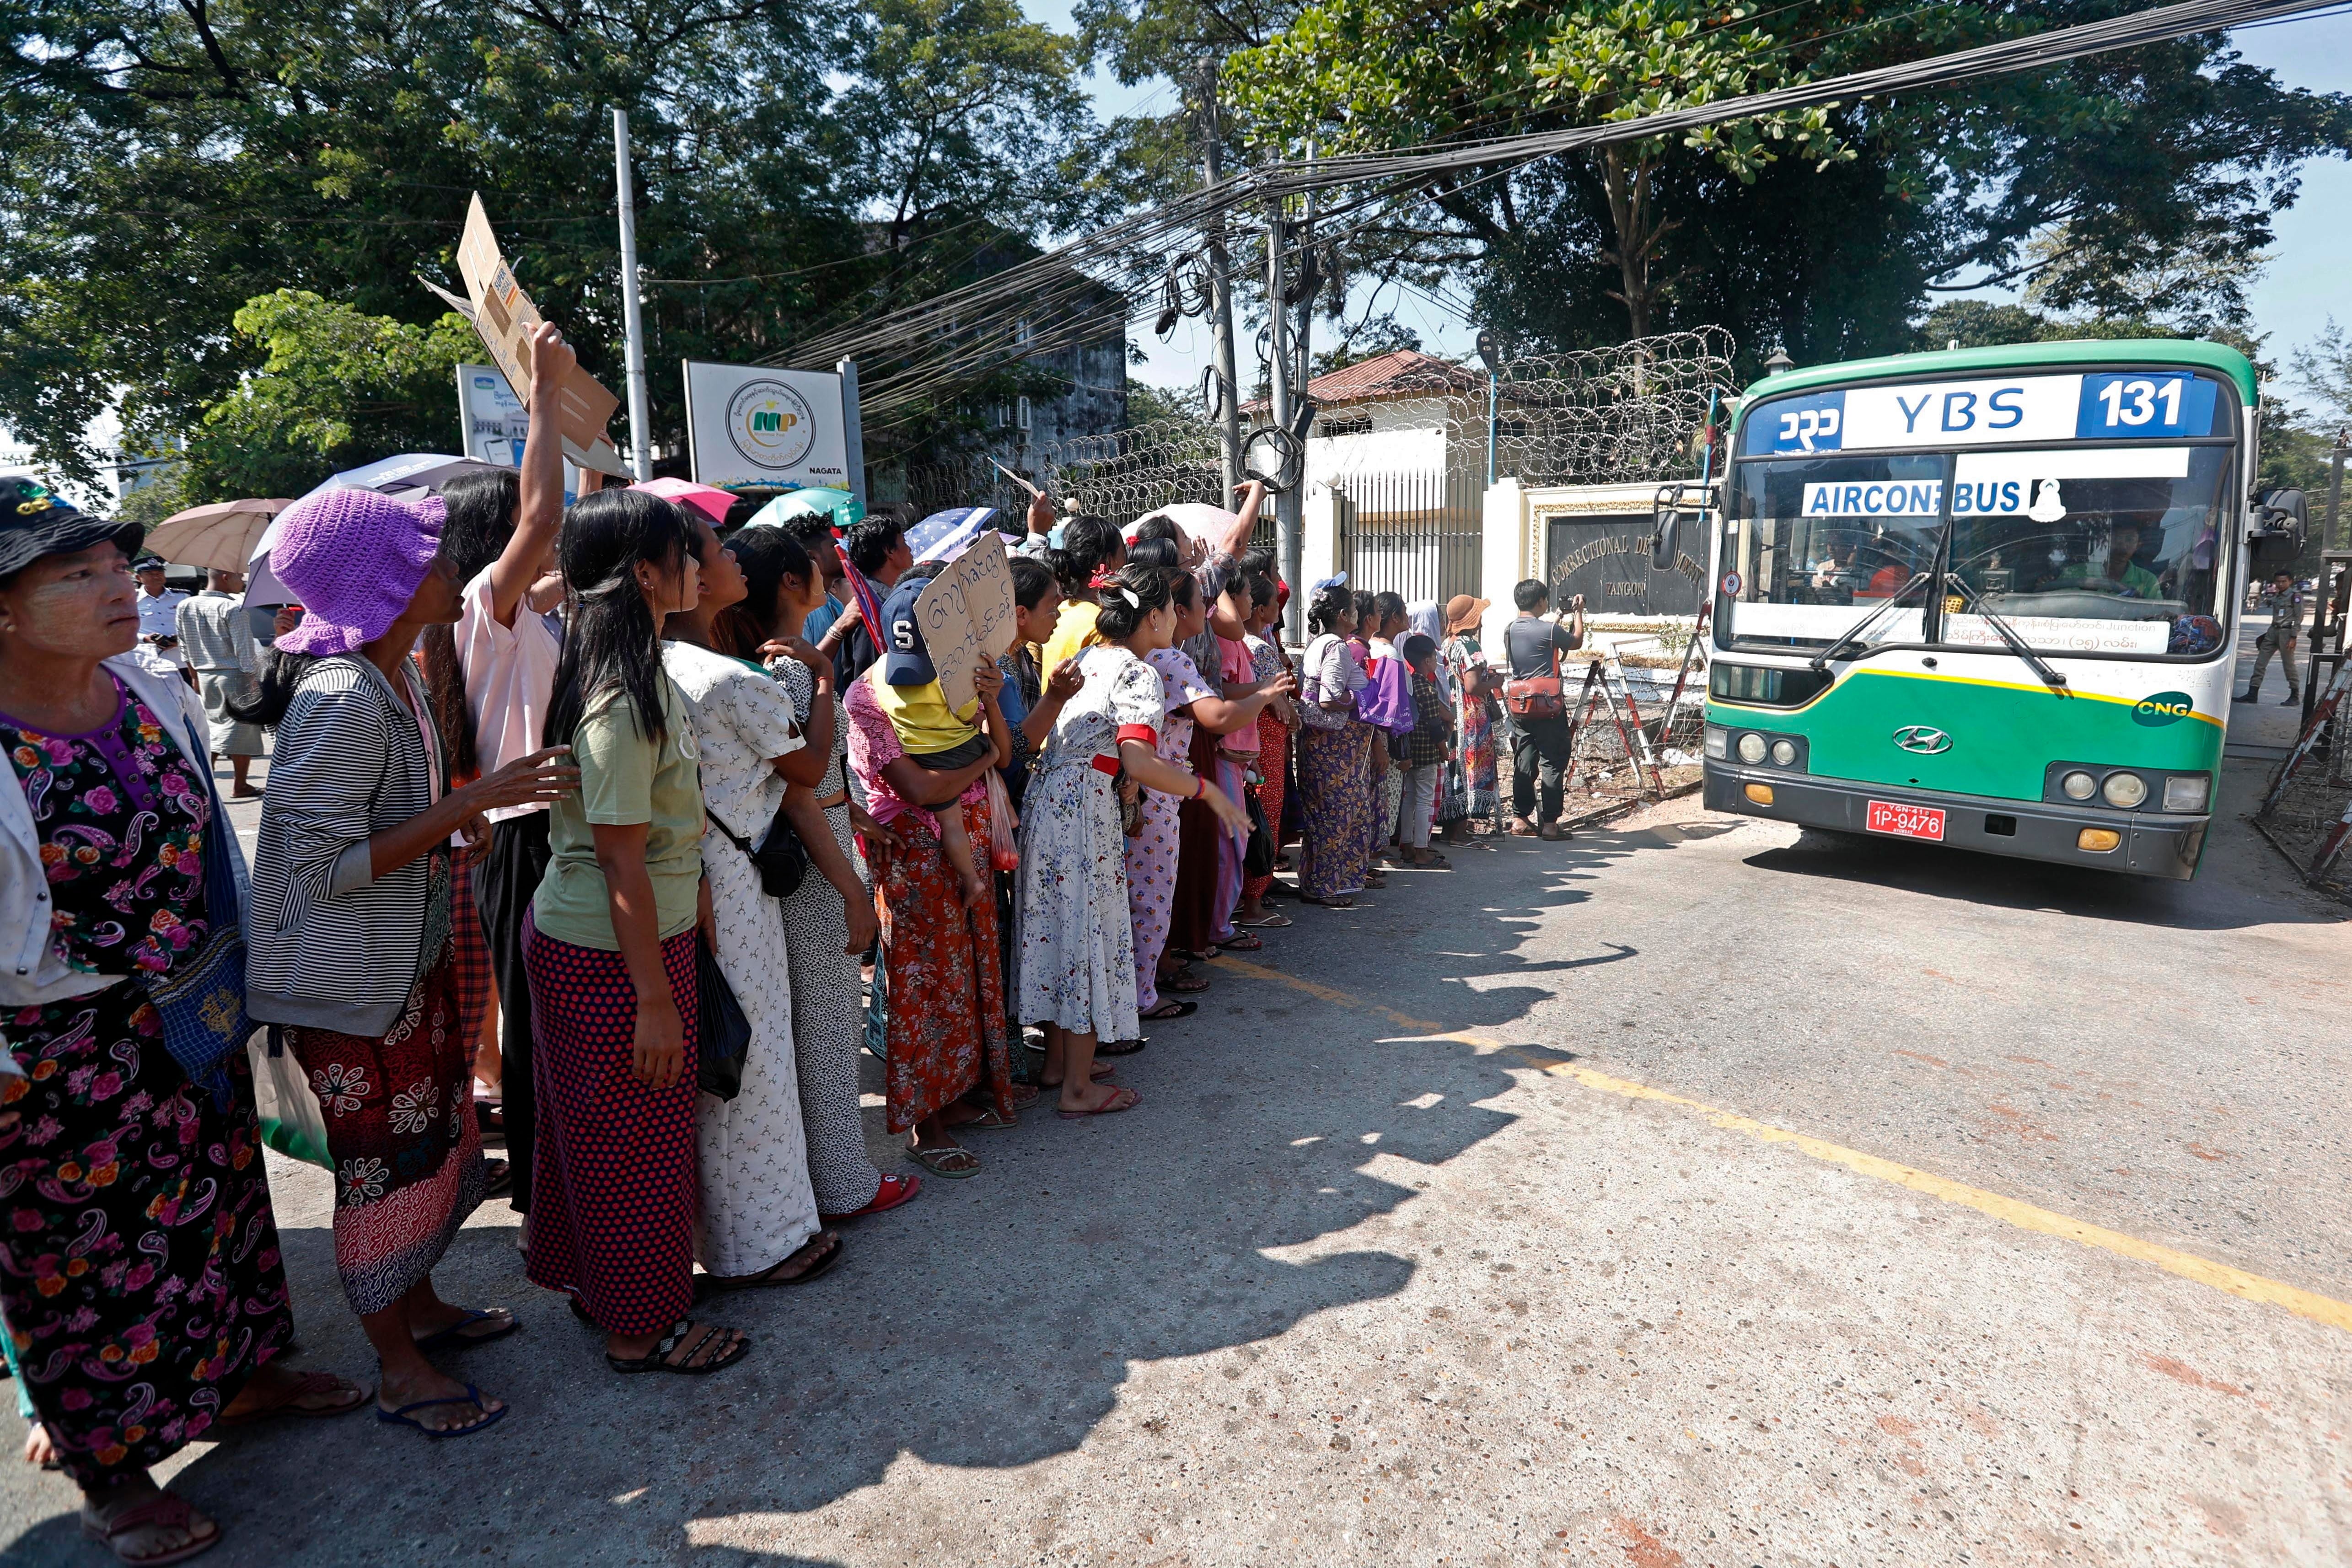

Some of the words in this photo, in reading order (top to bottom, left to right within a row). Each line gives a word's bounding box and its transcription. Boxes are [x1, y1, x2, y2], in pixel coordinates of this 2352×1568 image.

[494, 268, 506, 291] SUPER
[500, 278, 512, 300] CEREAL
[1896, 388, 2024, 433] YBS
[2099, 378, 2183, 427] 131
[809, 467, 842, 475] NAGATA
[1953, 482, 2020, 513] BUS
[1551, 535, 1629, 587] CORRECTIONAL
[1606, 582, 1646, 596] YANGON
[893, 620, 914, 649] S
[2106, 622, 2156, 632] Junction
[2138, 701, 2188, 717] CNG
[1874, 810, 1939, 833] 1P-9476
